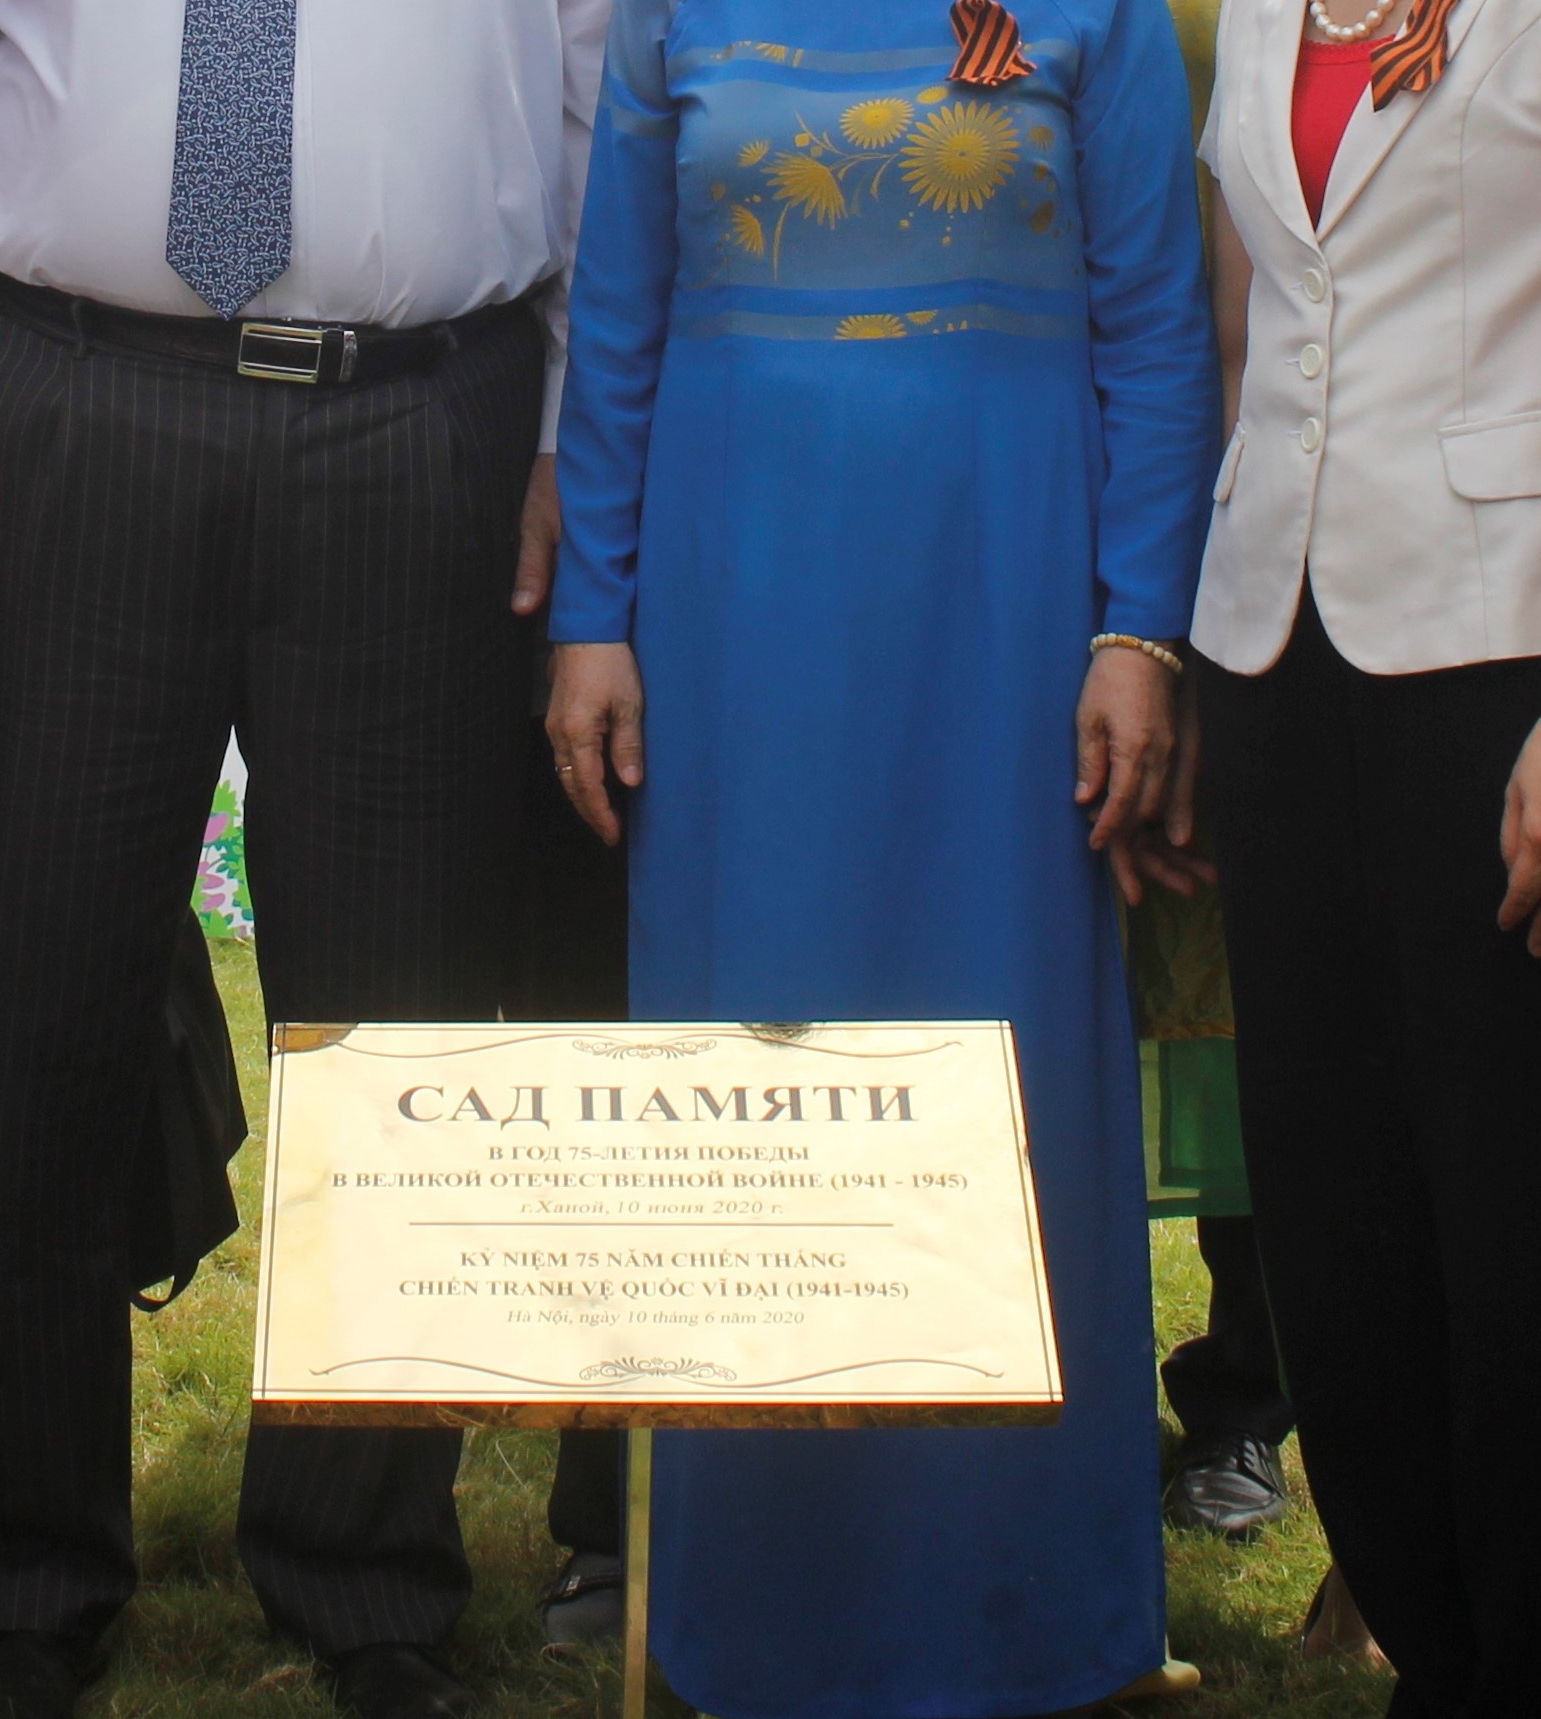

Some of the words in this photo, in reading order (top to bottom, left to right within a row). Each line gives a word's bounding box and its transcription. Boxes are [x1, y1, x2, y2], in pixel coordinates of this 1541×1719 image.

[397, 1085, 551, 1132] САД
[578, 1085, 917, 1122] ПАМЯТИ
[489, 1145, 504, 1161] В
[512, 1145, 562, 1163] ГОД
[567, 1145, 689, 1161] 75-ЛЕТИЯ
[697, 1145, 809, 1164] ПОБЕДЫ
[332, 1172, 348, 1188] В
[355, 1169, 482, 1188] ВЕЛИКОЙ
[489, 1169, 725, 1188] ОТЕЧЕСТВЕННОЙ
[732, 1170, 823, 1188] ВОЙНЕ
[830, 1173, 887, 1192] (1941
[911, 1172, 969, 1191] 1945)
[617, 1200, 641, 1214] 10
[647, 1203, 705, 1214] июня
[711, 1199, 764, 1215] 2020
[503, 1249, 568, 1271] NIỆM
[575, 1251, 600, 1268] 75
[606, 1248, 664, 1268] NĂM
[485, 1280, 574, 1297] TRANH
[580, 1277, 616, 1301] VỆ
[701, 1277, 728, 1297] VĨ
[735, 1281, 779, 1302] ĐẠI
[786, 1281, 909, 1300] (1941-1945)
[507, 1309, 531, 1323] Hà
[536, 1309, 574, 1326] Nội,
[578, 1310, 621, 1327] ngày
[628, 1310, 648, 1324] 10
[652, 1310, 700, 1328] tháng
[704, 1310, 715, 1324] 6
[720, 1311, 757, 1325] năm
[761, 1310, 805, 1325] 2020
